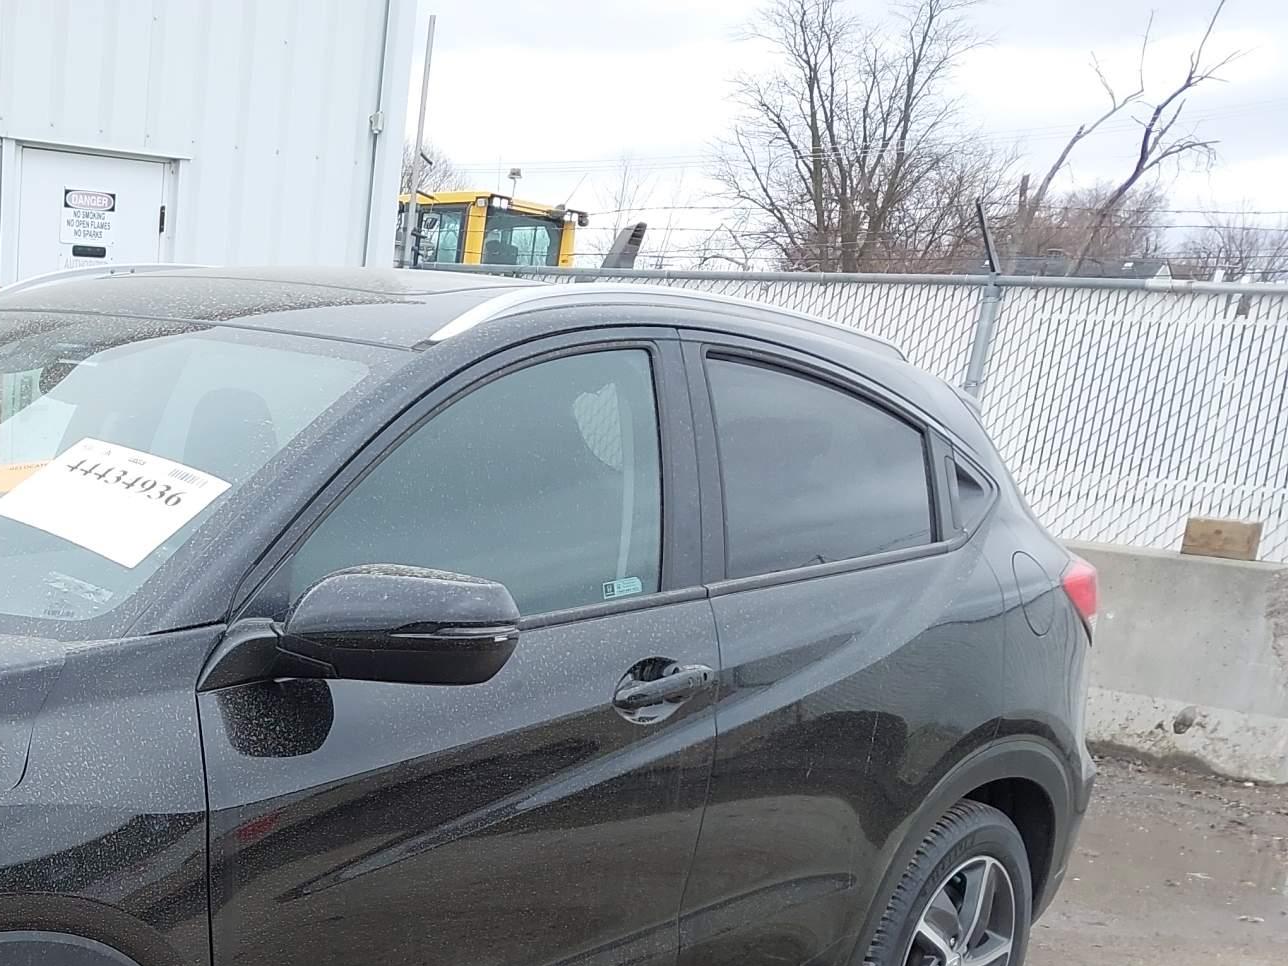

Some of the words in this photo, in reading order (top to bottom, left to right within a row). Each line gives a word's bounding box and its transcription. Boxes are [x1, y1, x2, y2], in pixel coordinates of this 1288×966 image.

[72, 193, 109, 207] DANGER
[73, 210, 81, 219] NO
[82, 211, 106, 220] SMOKING
[66, 219, 74, 227] NO
[75, 220, 90, 229] OPEN
[90, 221, 111, 230] FLAMES
[73, 229, 81, 237] NO
[82, 230, 103, 239] SPARKS
[66, 459, 187, 507] 44434936
